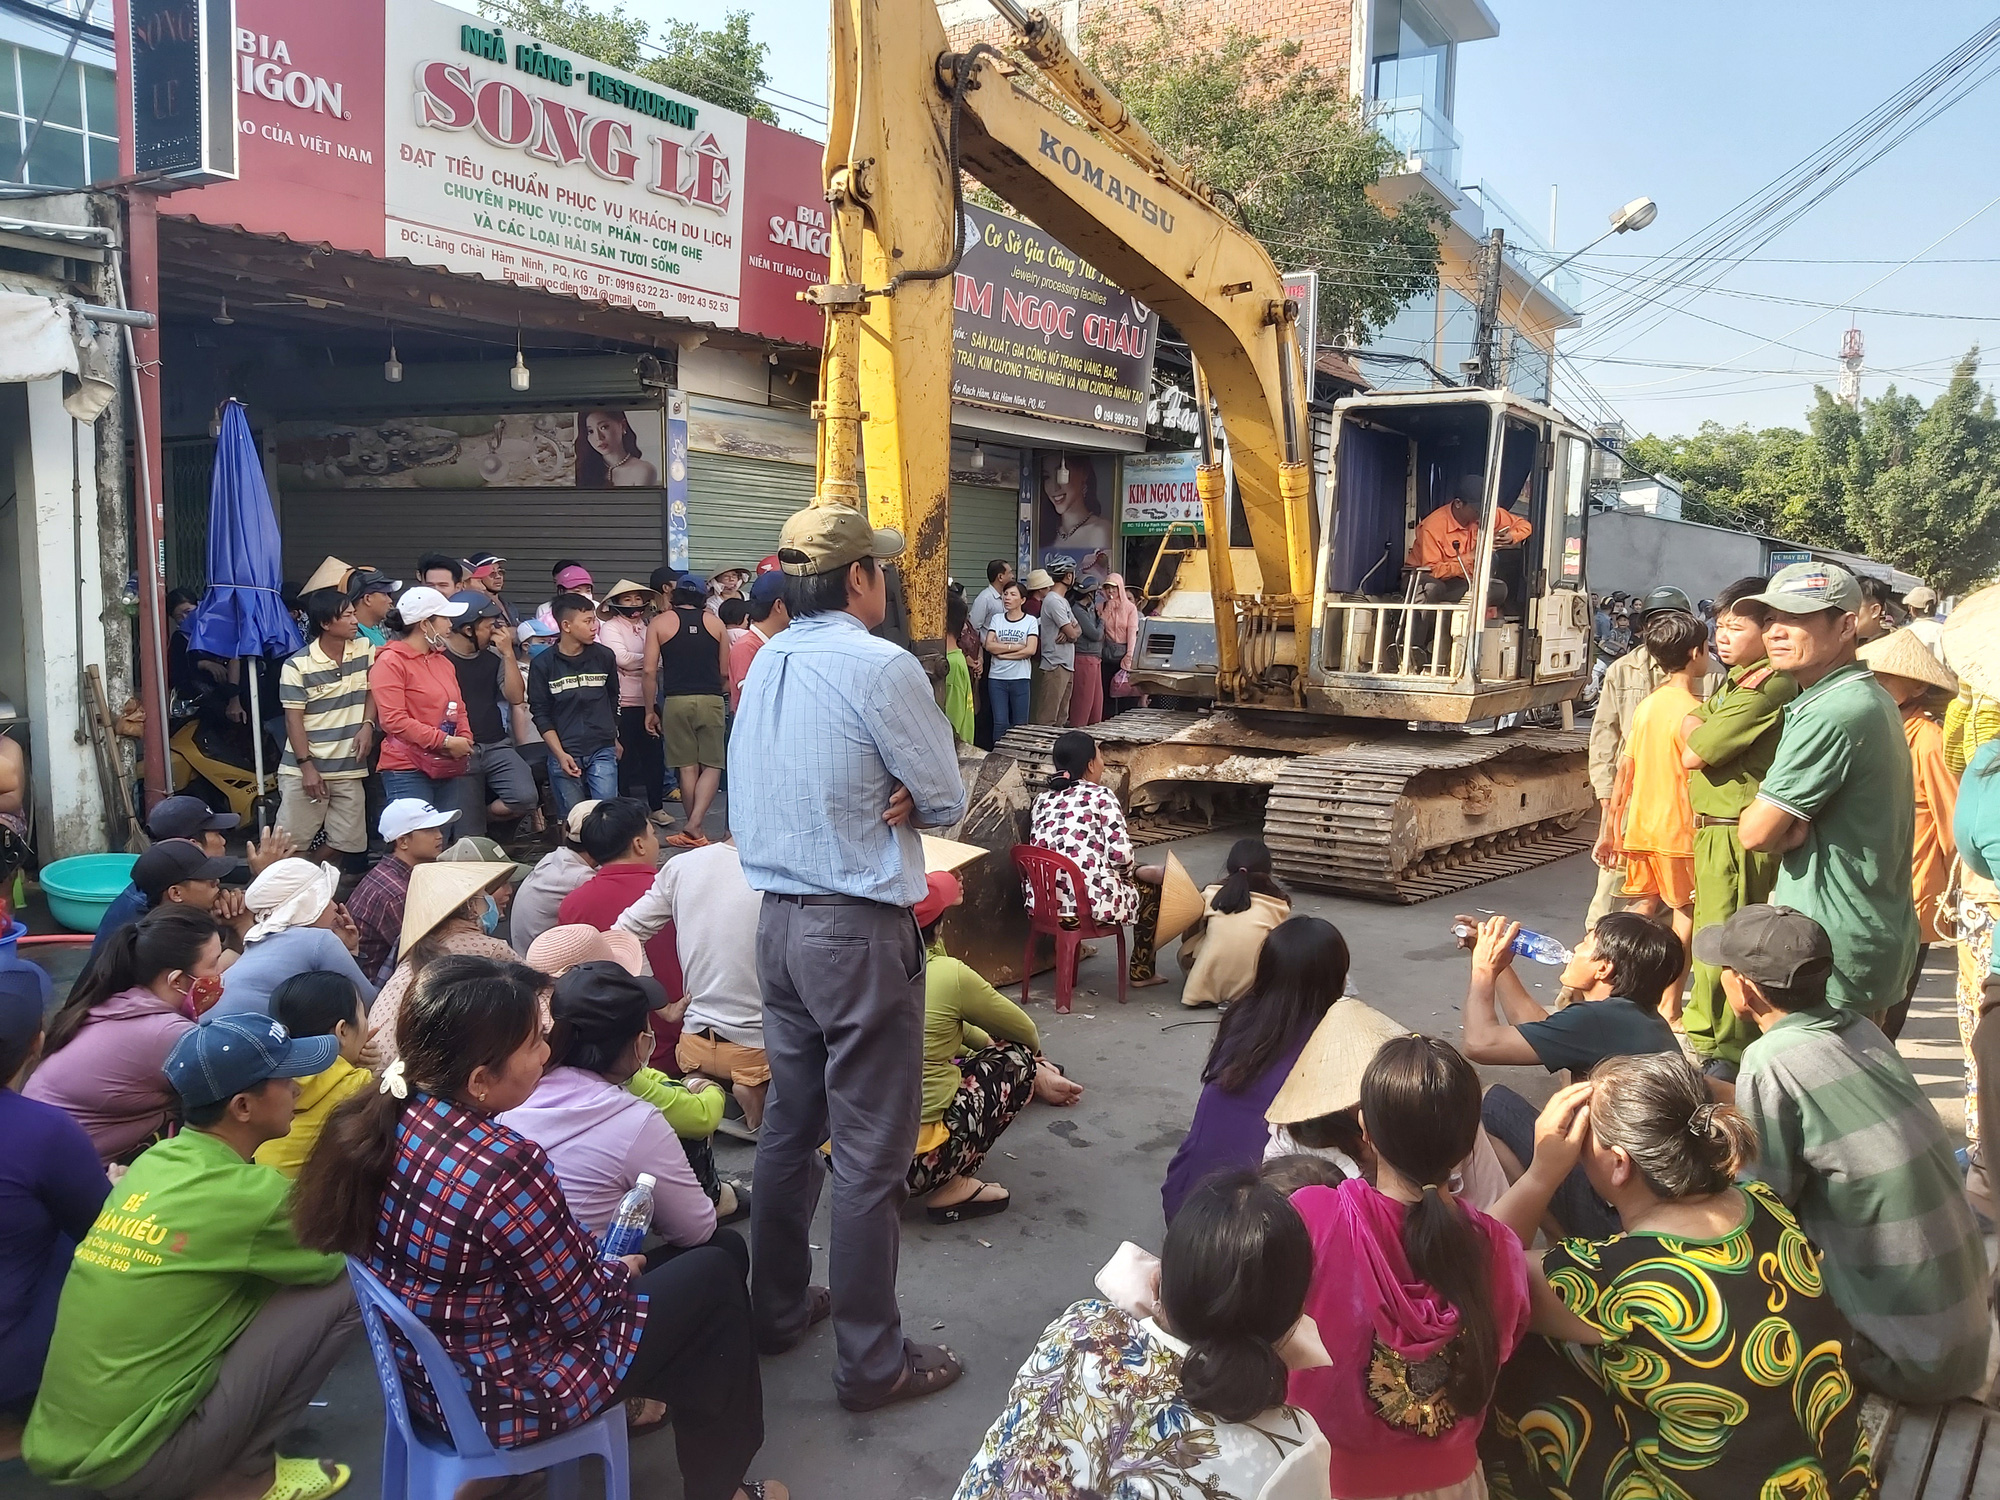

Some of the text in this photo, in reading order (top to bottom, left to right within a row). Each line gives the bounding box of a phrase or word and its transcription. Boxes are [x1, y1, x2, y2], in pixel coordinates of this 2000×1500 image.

[237, 27, 292, 66] BIA
[237, 55, 343, 119] IGON
[461, 25, 507, 64] NHÀ
[516, 42, 573, 87] HÀNG
[588, 71, 699, 130] RESTAURANT
[261, 122, 295, 146] CỦA
[299, 133, 332, 156] VIỆT
[337, 143, 373, 165] NAM
[414, 59, 732, 217] SONG LÊ
[400, 143, 732, 250] ĐẠT TIÊU CHUẨN PHỤC VỤ KHÁCH DU LỊCH
[1038, 128, 1175, 234] KOMATSU
[443, 181, 504, 209] CHUYÊN
[508, 198, 544, 221] PHỤC
[608, 225, 641, 245] PHẦN
[652, 237, 678, 255] CƠM
[681, 245, 703, 264] GHẸ
[769, 216, 831, 258] SAIGO
[796, 205, 825, 229] BIA
[473, 211, 680, 275] VÀ CÁC LOẠI HẢI SẢN TƯƠI SỐNG
[984, 223, 1003, 248] Cơ
[1004, 229, 1023, 255] Sở
[1024, 237, 1045, 265] Gia
[1048, 246, 1076, 278] Công
[460, 243, 485, 259] Chài
[491, 249, 515, 265] Hàm
[521, 256, 547, 274] Ninh,
[552, 263, 570, 279] PQ,
[573, 268, 588, 281] KG
[597, 274, 613, 287] ĐT:
[615, 278, 635, 292] 0919
[636, 282, 646, 294] 63
[647, 284, 658, 297] 22
[677, 292, 695, 306] 0912
[697, 297, 707, 308] 43
[708, 299, 718, 311] 52
[719, 302, 729, 313] 53
[503, 267, 533, 284] Email:
[749, 253, 771, 271] NIỀM
[772, 261, 784, 276] TỰ
[785, 263, 803, 279] HÀO
[805, 267, 821, 284] CỦA
[1011, 265, 1041, 288] Jewelry
[1040, 275, 1080, 300] processing
[953, 271, 1148, 359] IM NGỌC CHÂU
[970, 331, 989, 350] SẢN
[1012, 343, 1025, 358] GIA
[1025, 344, 1047, 364] CÔNG
[1060, 354, 1083, 372] TRANG
[957, 349, 976, 370] TRAI,
[977, 355, 993, 371] KIM
[993, 359, 1022, 378] CƯƠNG
[1066, 373, 1076, 390] VÀ
[1076, 377, 1090, 393] KIM
[1089, 380, 1114, 398] CƯƠNG
[1132, 390, 1144, 406] TẠO
[1128, 483, 1148, 504] KIM
[1149, 482, 1178, 509] NGỌC
[998, 629, 1025, 639] DICKIES
[121, 1191, 150, 1213] BÉ
[110, 1241, 131, 1257] Hàm
[132, 1248, 163, 1266] Ninh
[110, 1258, 130, 1273] 849
